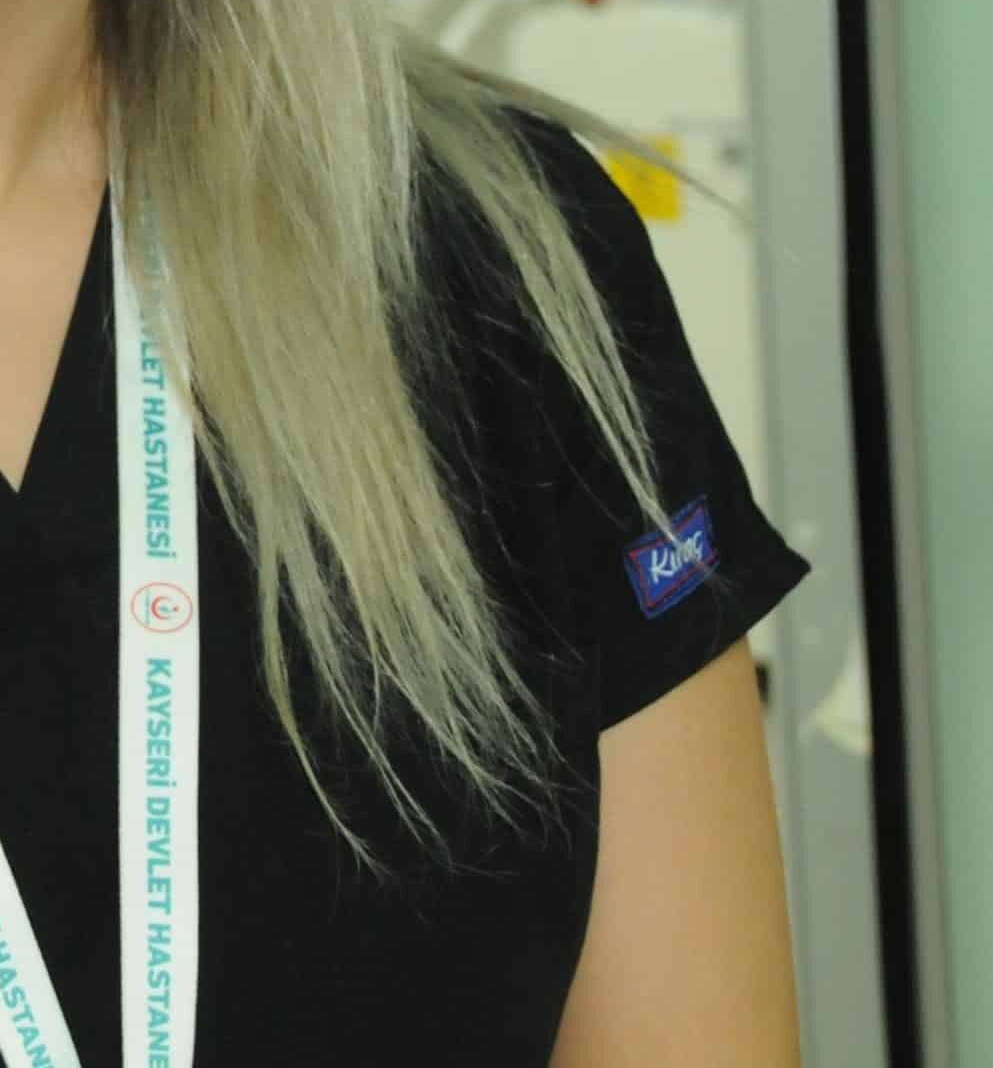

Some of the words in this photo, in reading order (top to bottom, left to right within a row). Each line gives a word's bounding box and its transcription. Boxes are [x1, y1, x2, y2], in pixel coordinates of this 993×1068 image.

[142, 392, 176, 561] HASTANESİ
[144, 657, 177, 790] KAYSERİ
[144, 795, 175, 917] DEVLET
